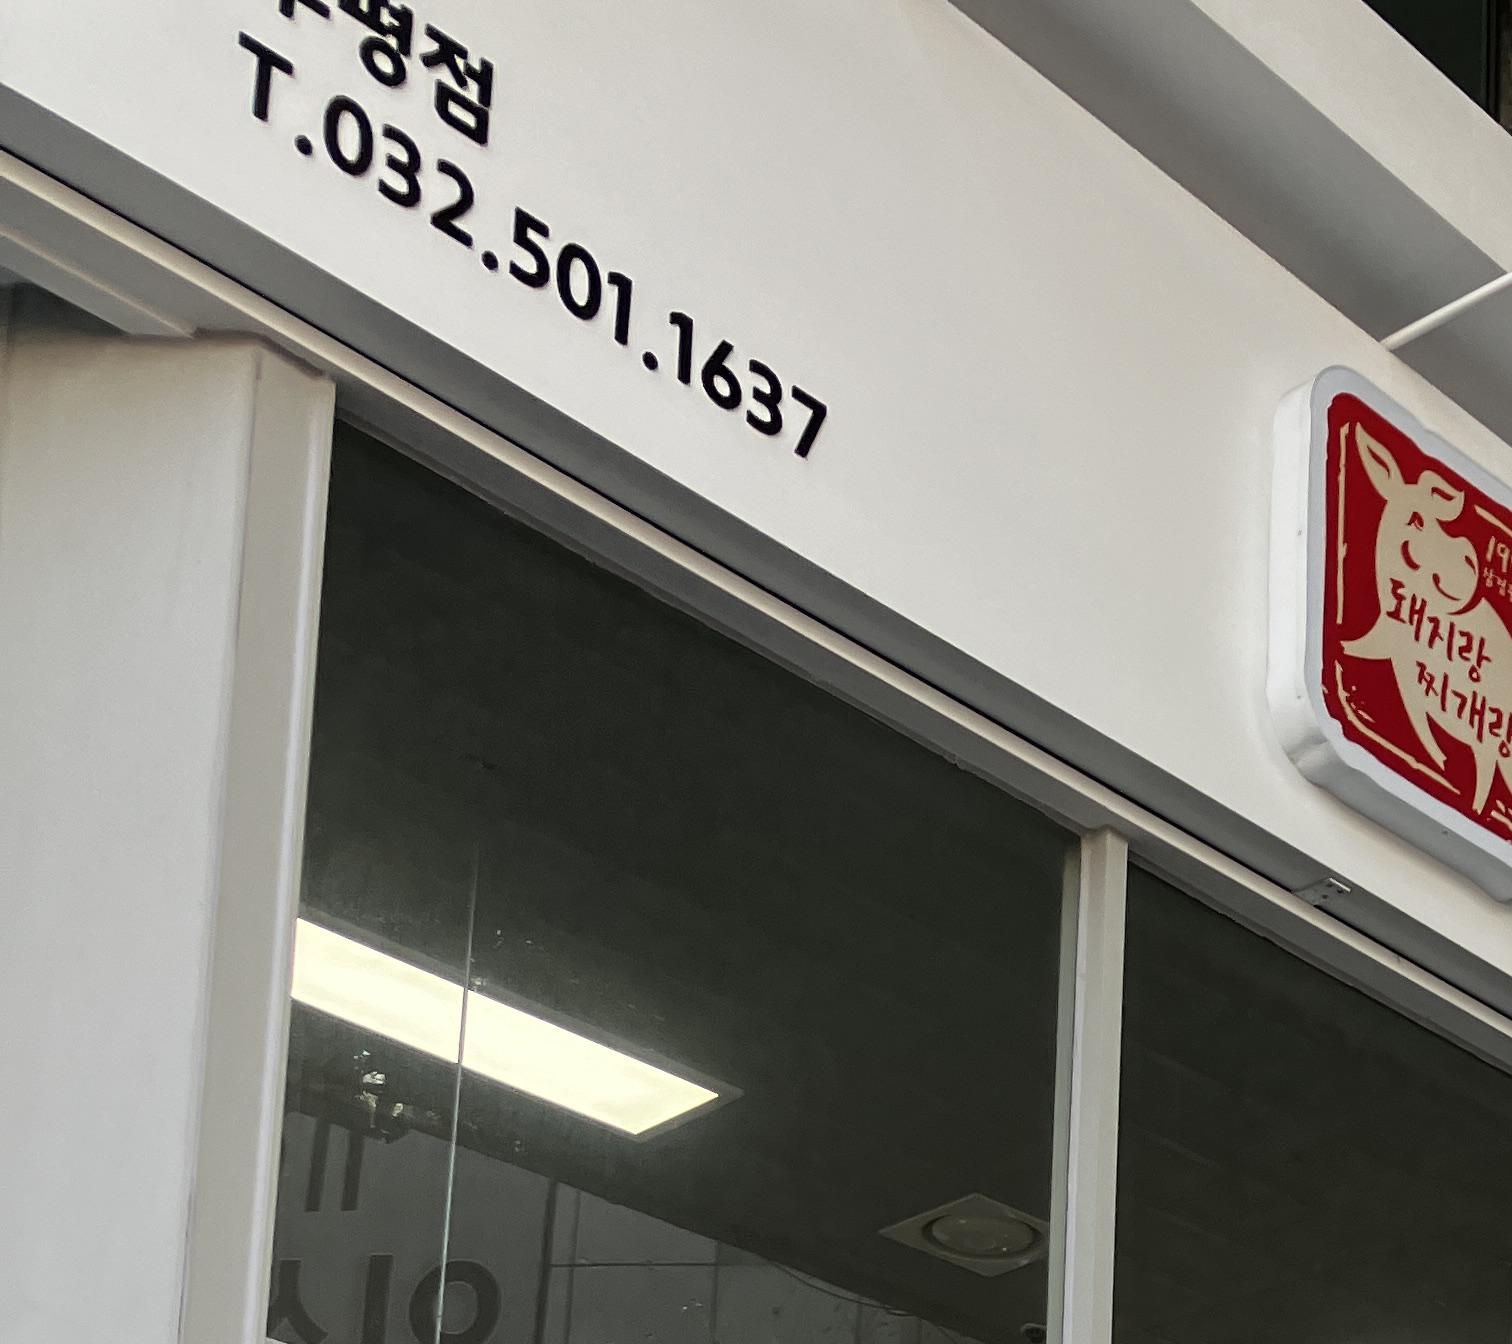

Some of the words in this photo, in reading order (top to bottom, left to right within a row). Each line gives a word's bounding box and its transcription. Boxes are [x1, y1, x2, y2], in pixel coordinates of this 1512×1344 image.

[279, 0, 494, 146] 평점
[236, 32, 829, 459] T.032.501.1637
[1386, 577, 1494, 683] 돼지랑
